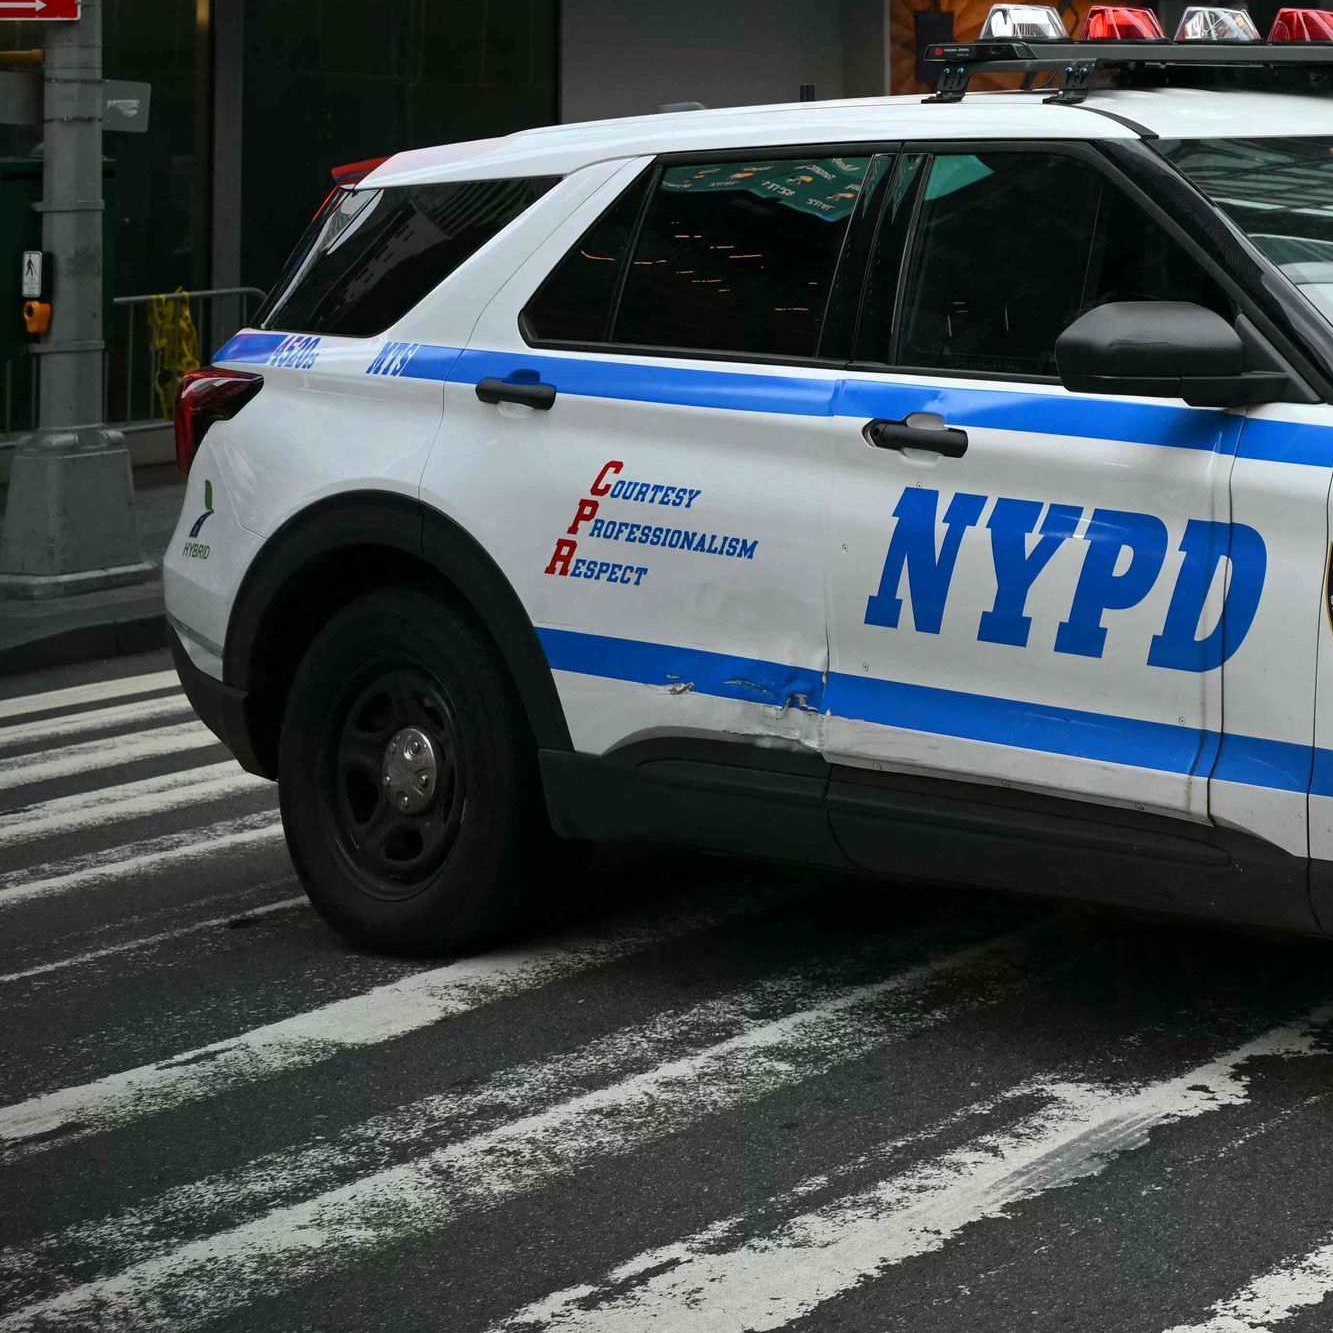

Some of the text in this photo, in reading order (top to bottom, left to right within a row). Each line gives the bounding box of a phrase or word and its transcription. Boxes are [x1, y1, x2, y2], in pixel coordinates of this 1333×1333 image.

[590, 460, 702, 509] COURTESY
[182, 542, 210, 560] HYBRID
[567, 498, 760, 559] PROFESSIONALISM
[544, 538, 649, 586] RESPECT
[864, 486, 1268, 674] NYPD
